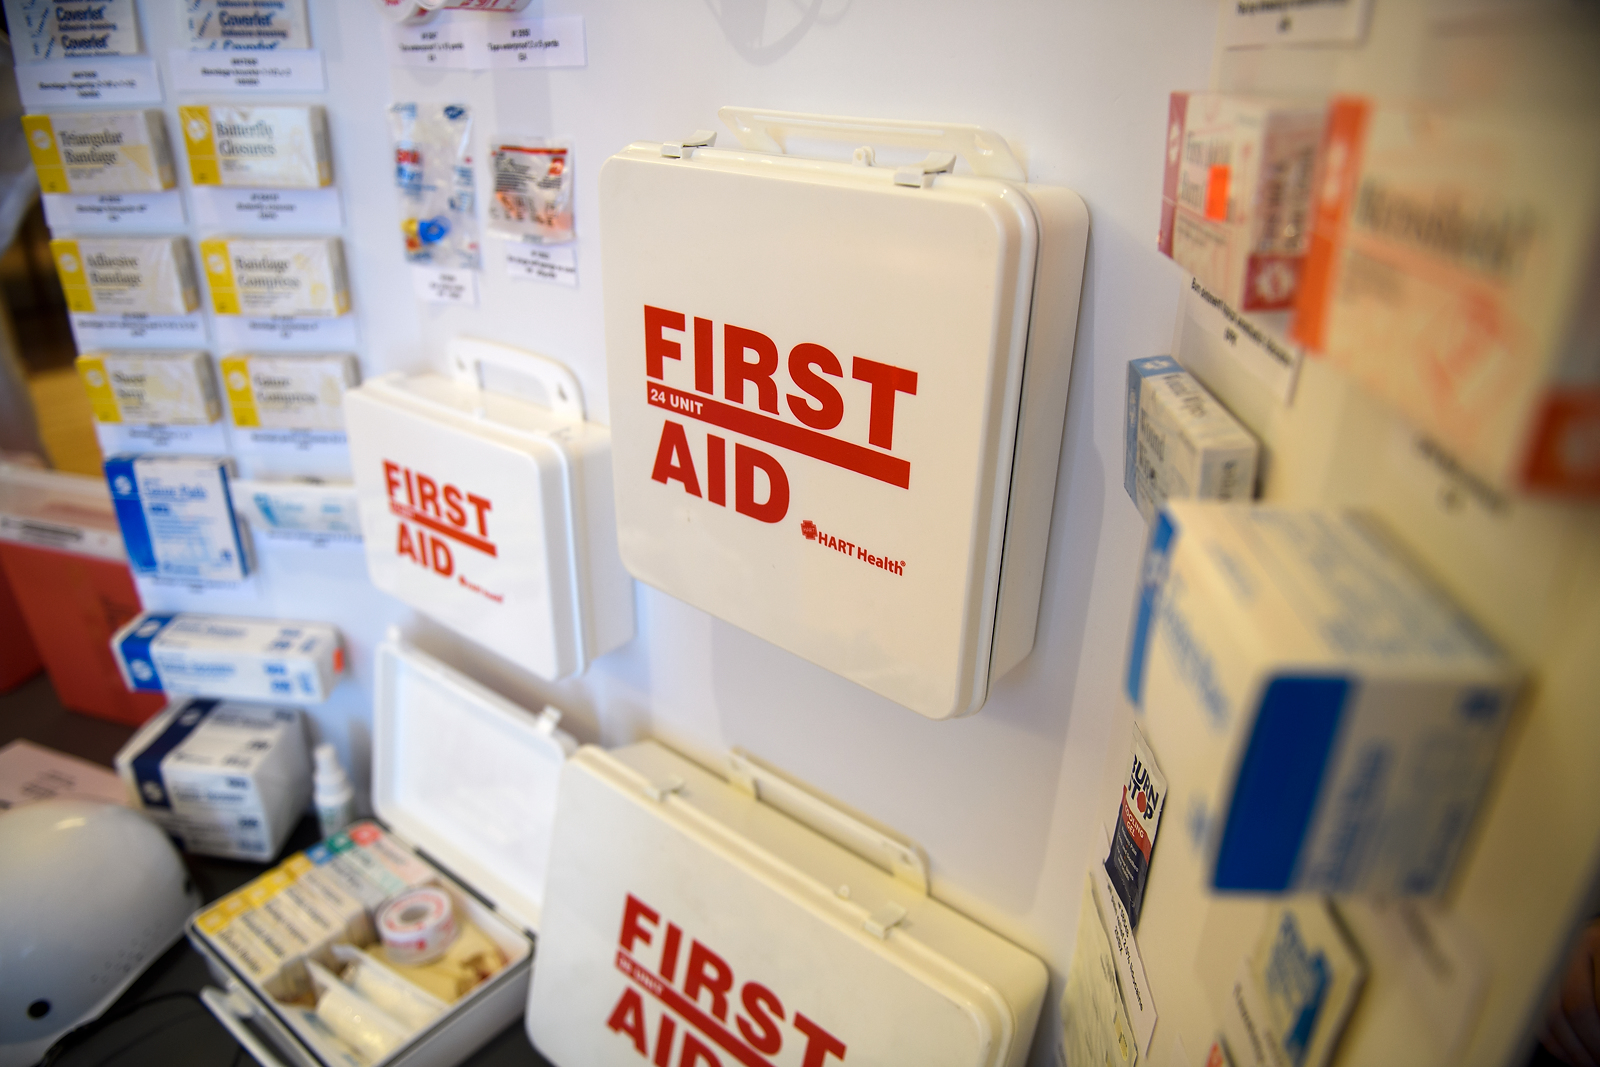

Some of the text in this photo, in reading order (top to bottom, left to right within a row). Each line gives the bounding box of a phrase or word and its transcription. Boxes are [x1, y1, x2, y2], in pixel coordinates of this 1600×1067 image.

[59, 128, 123, 147] Triangular
[644, 304, 918, 451] FIRST
[650, 388, 703, 415] 24 UNIT
[383, 459, 492, 537] FIRST
[651, 419, 790, 524] AID
[397, 522, 455, 578] AID
[818, 531, 855, 556] HART
[1126, 821, 1135, 837] GEL
[619, 891, 847, 1067] FIRST
